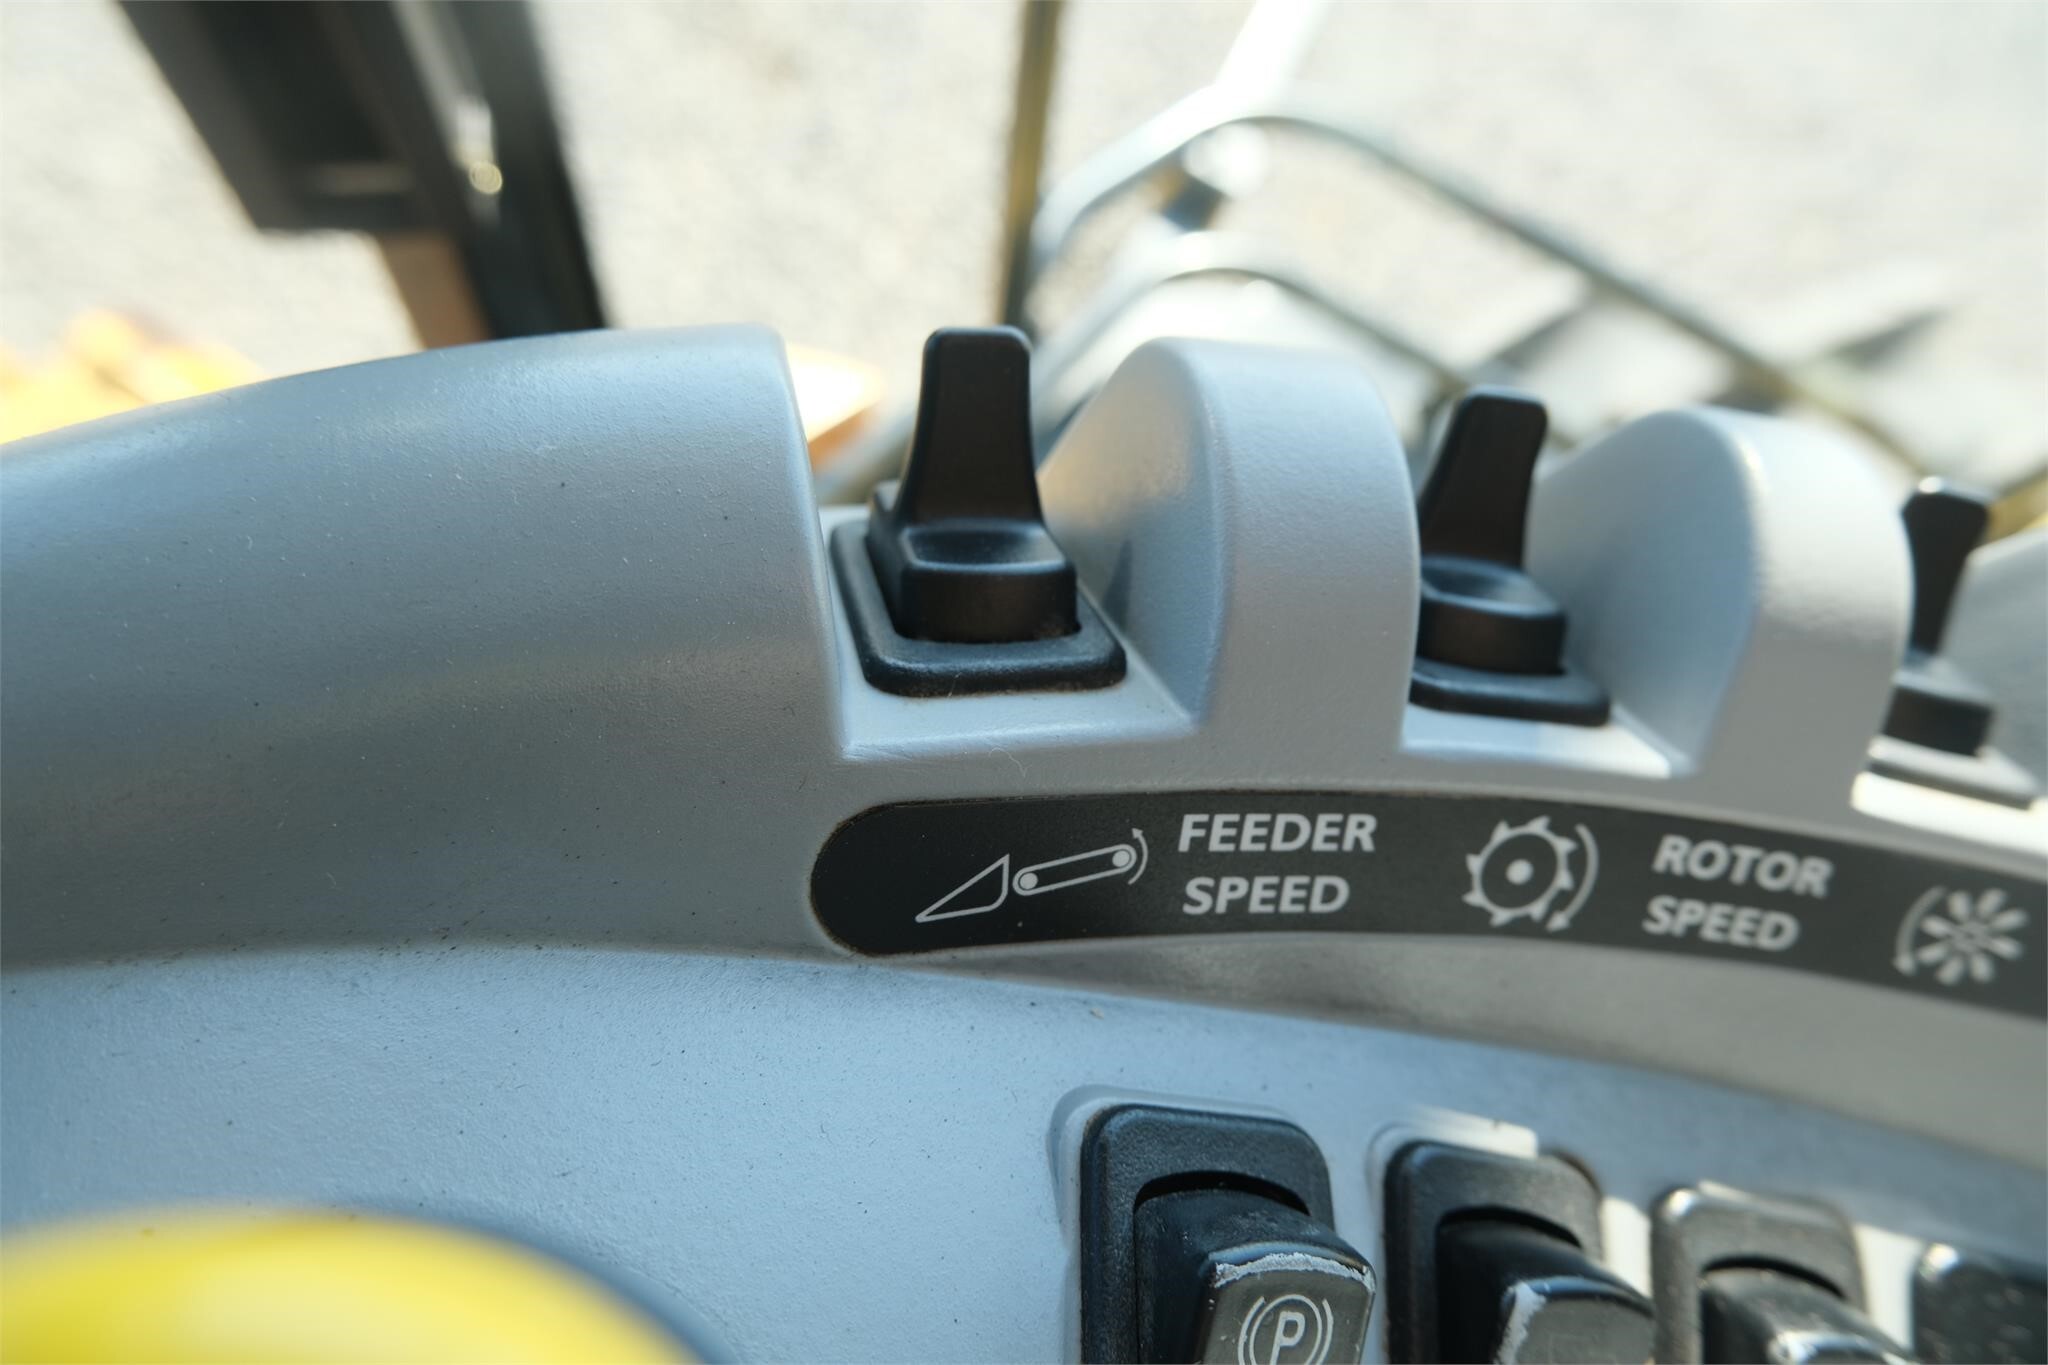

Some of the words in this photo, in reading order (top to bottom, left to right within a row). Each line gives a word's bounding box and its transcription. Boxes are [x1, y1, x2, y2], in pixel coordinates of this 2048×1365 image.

[1178, 813, 1378, 852] FEEDER
[1652, 834, 1834, 897] ROTOR
[1182, 875, 1350, 915] SPEED
[1642, 895, 1801, 951] SPEED
[1269, 1310, 1306, 1365] P
